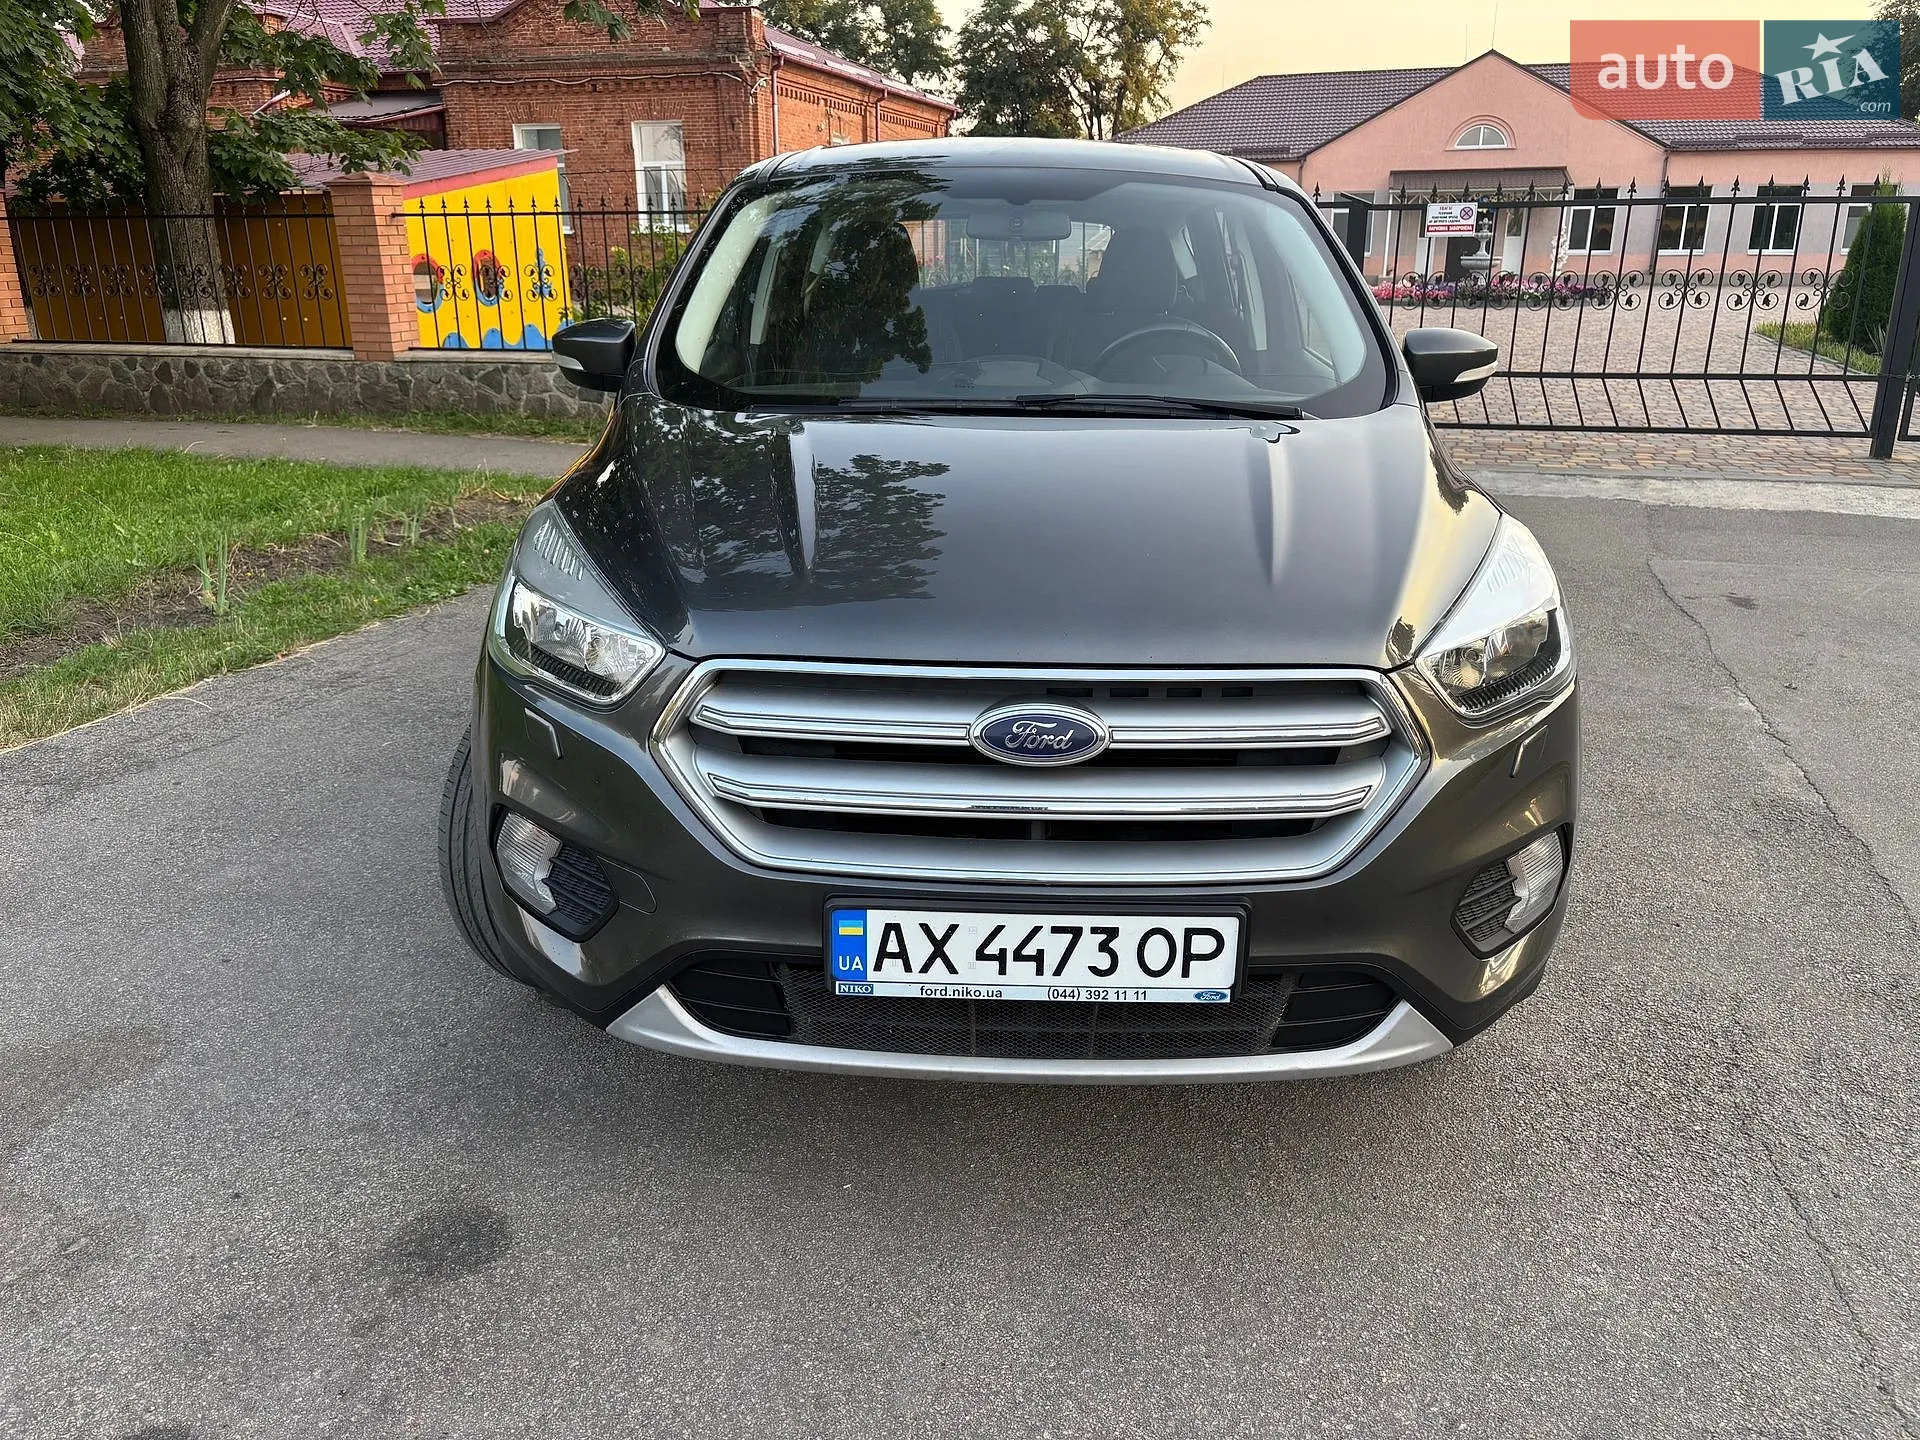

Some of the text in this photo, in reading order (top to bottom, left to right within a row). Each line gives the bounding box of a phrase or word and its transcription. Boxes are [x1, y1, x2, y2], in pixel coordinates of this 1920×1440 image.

[1004, 720, 1075, 749] Ford
[873, 922, 1225, 978] AX 4473 OP
[838, 955, 864, 971] UA
[840, 984, 873, 994] NIKO
[919, 985, 1003, 998] ford.niko.ua
[1047, 988, 1147, 1001] (044) 392 11 11
[1200, 991, 1221, 1001] Ford
